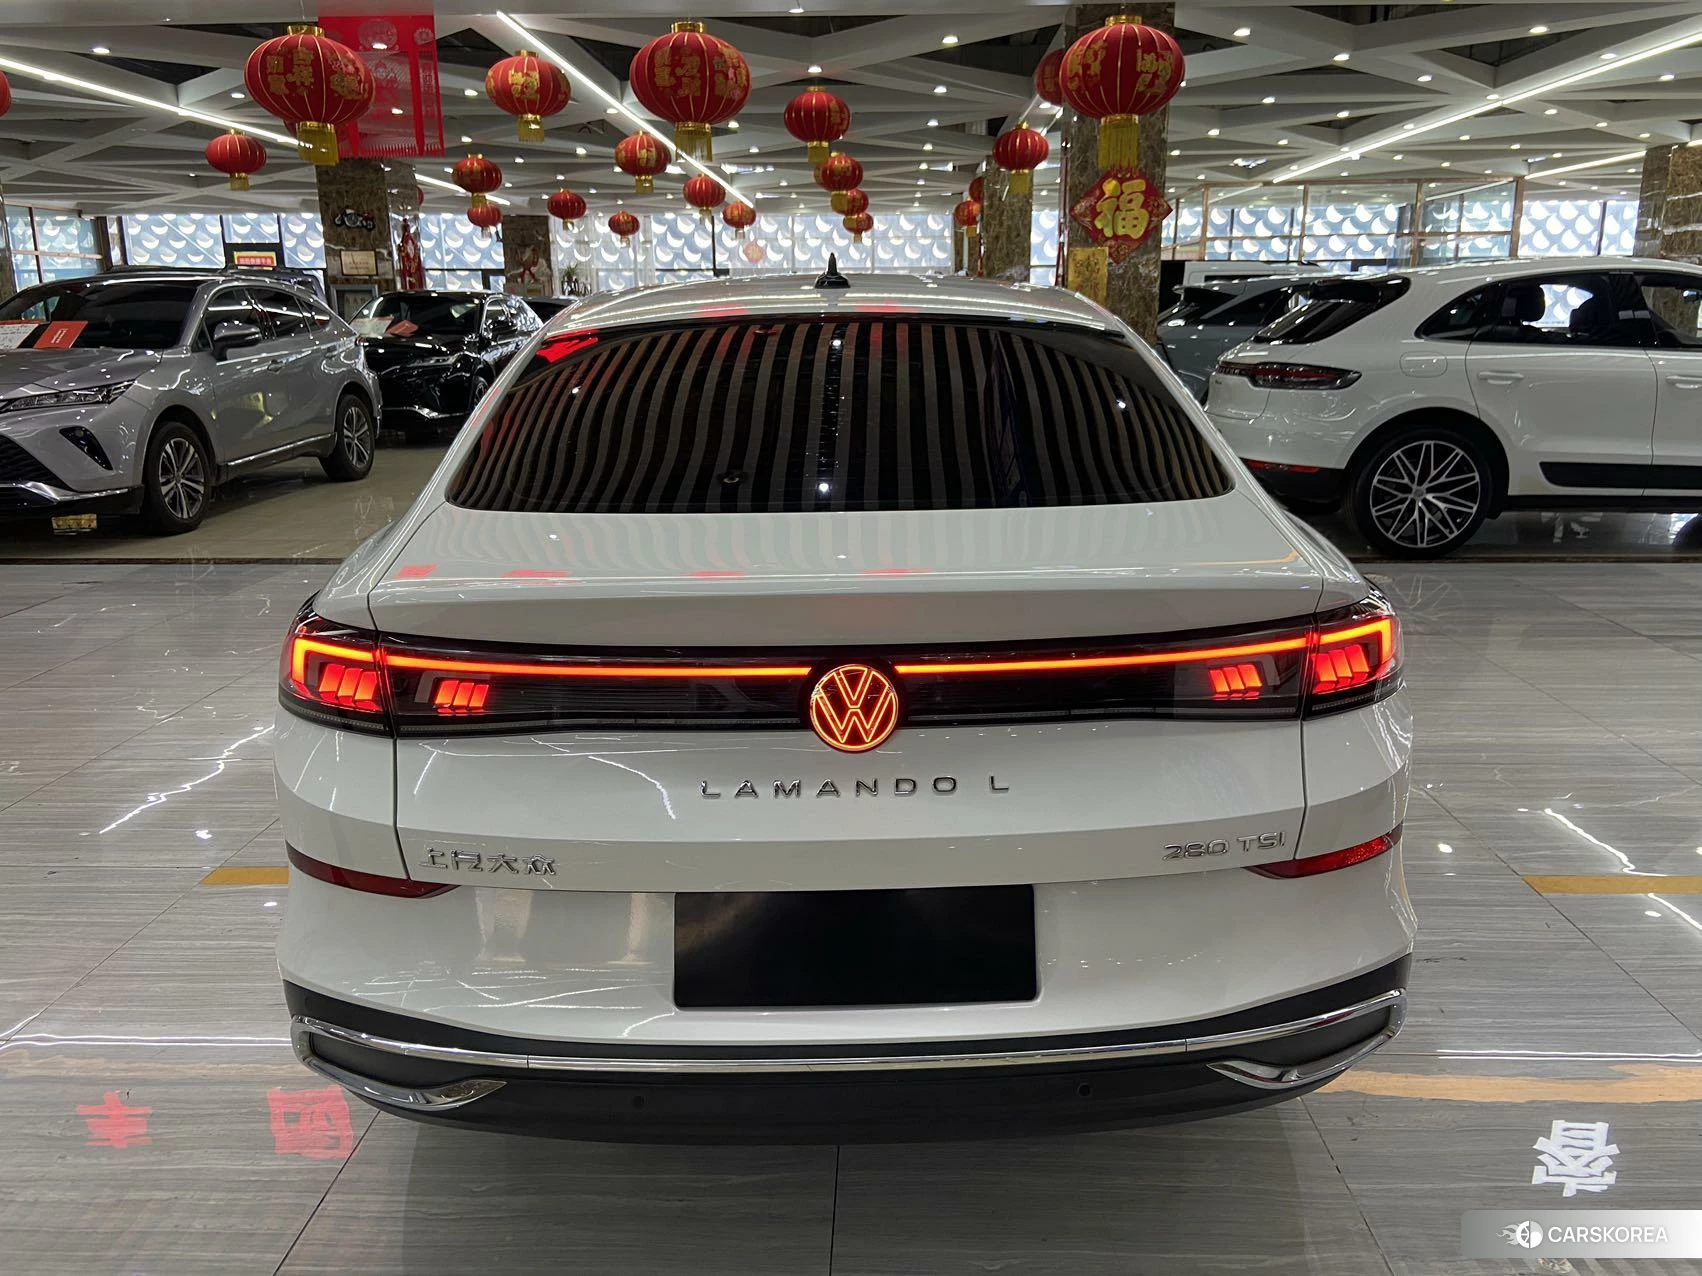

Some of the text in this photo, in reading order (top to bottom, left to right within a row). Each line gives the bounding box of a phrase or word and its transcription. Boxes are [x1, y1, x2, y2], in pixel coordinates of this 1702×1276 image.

[1094, 177, 1150, 240] 福
[701, 775, 1010, 798] LAMANDO L
[1162, 831, 1286, 861] 280 TSI
